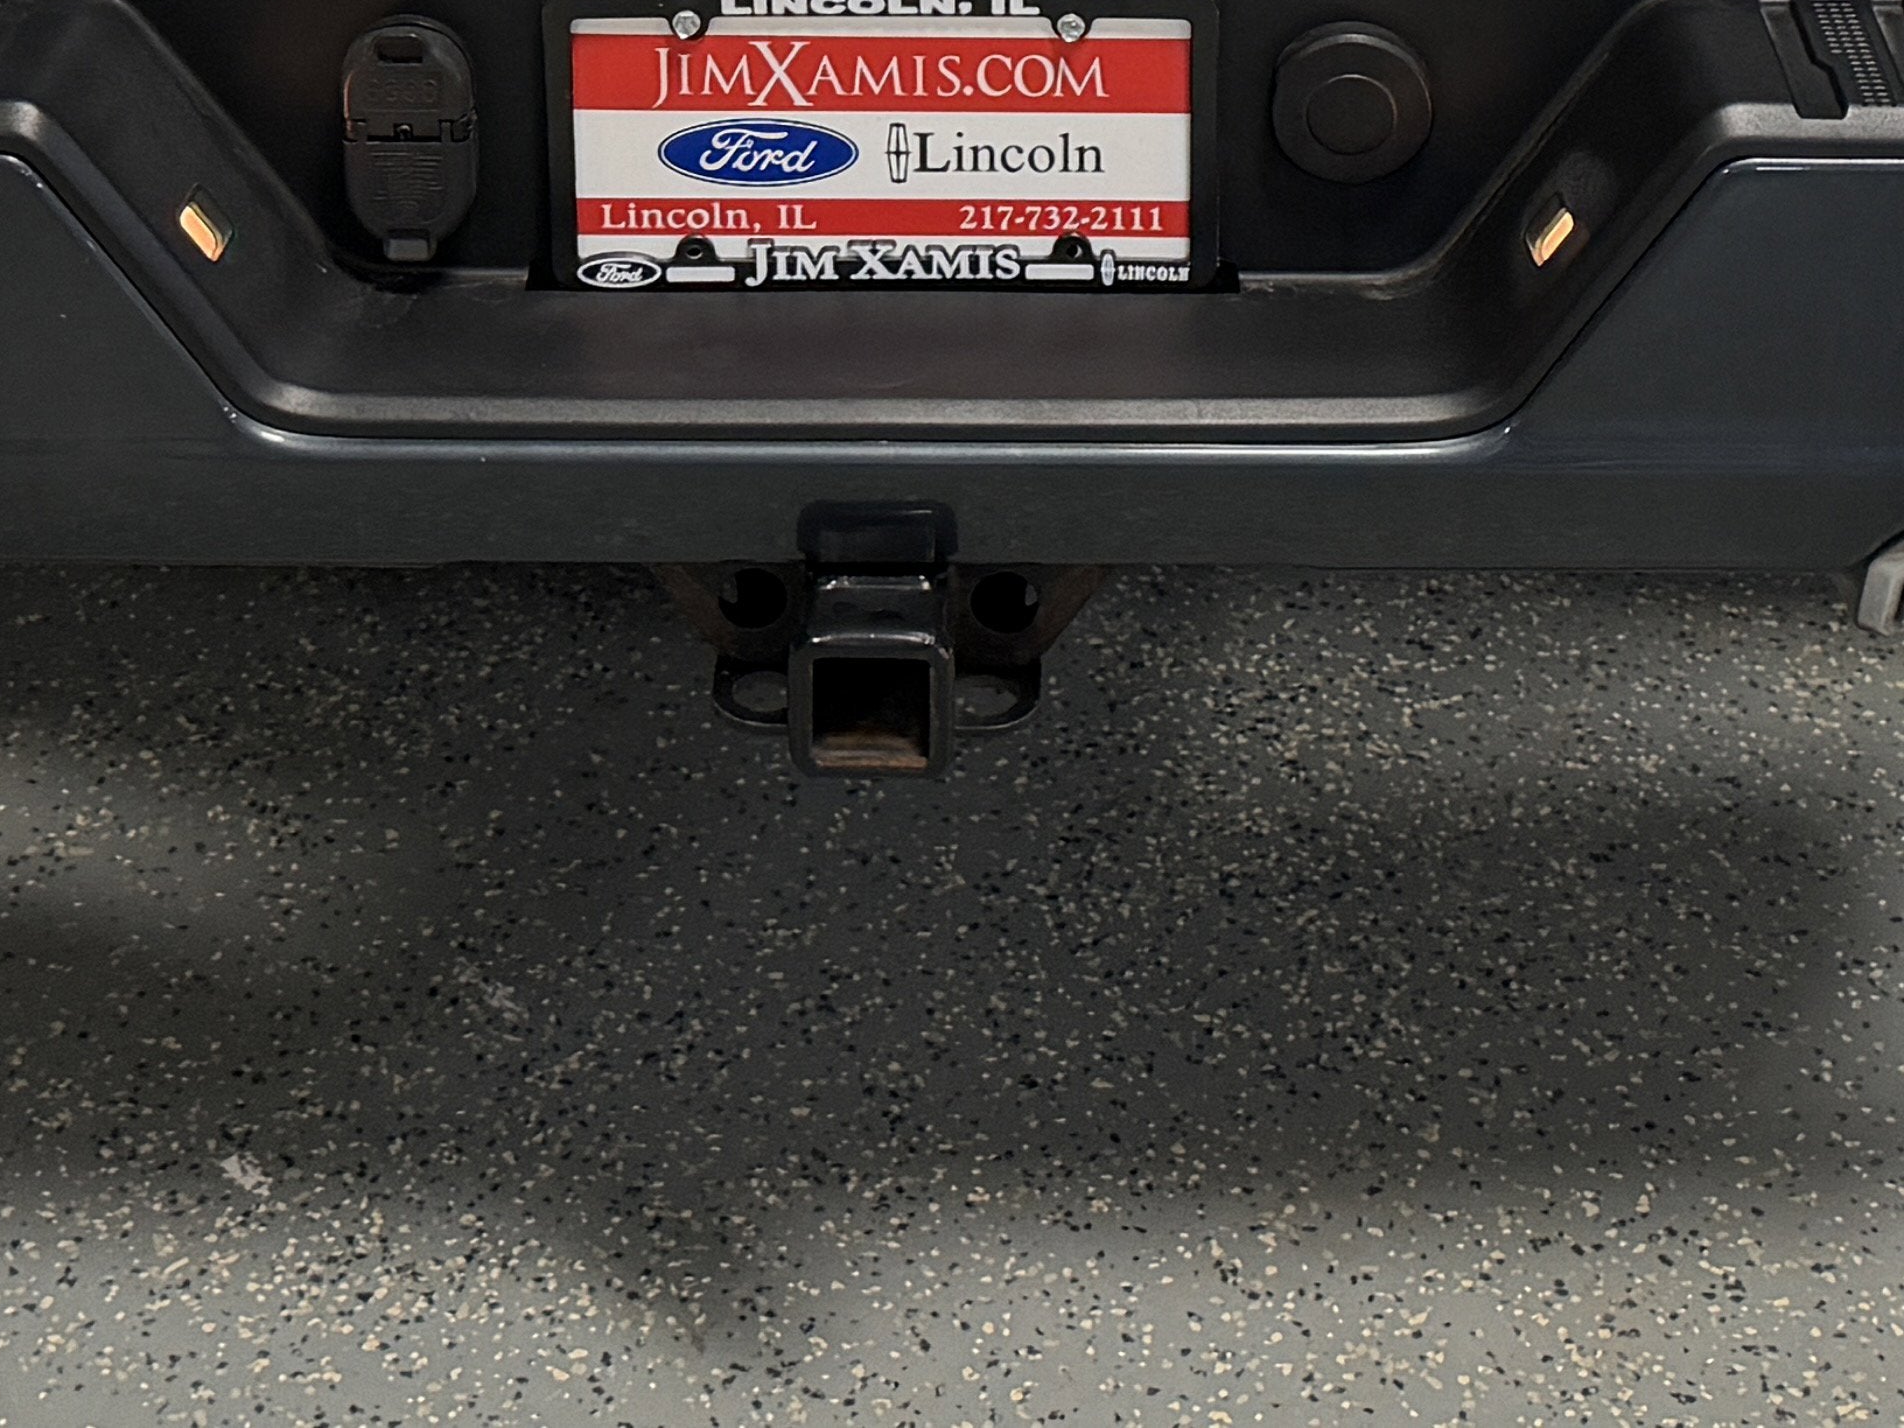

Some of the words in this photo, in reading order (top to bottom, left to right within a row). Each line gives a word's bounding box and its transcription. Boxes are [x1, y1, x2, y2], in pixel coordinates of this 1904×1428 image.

[698, 126, 817, 175] Ford
[913, 130, 1106, 175] Lincoln
[600, 202, 762, 234] Lincoln,
[777, 204, 818, 231] IL
[959, 205, 1165, 232] 217-732-2111
[596, 263, 645, 284] Ford
[1116, 266, 1192, 284] LINCOLN
